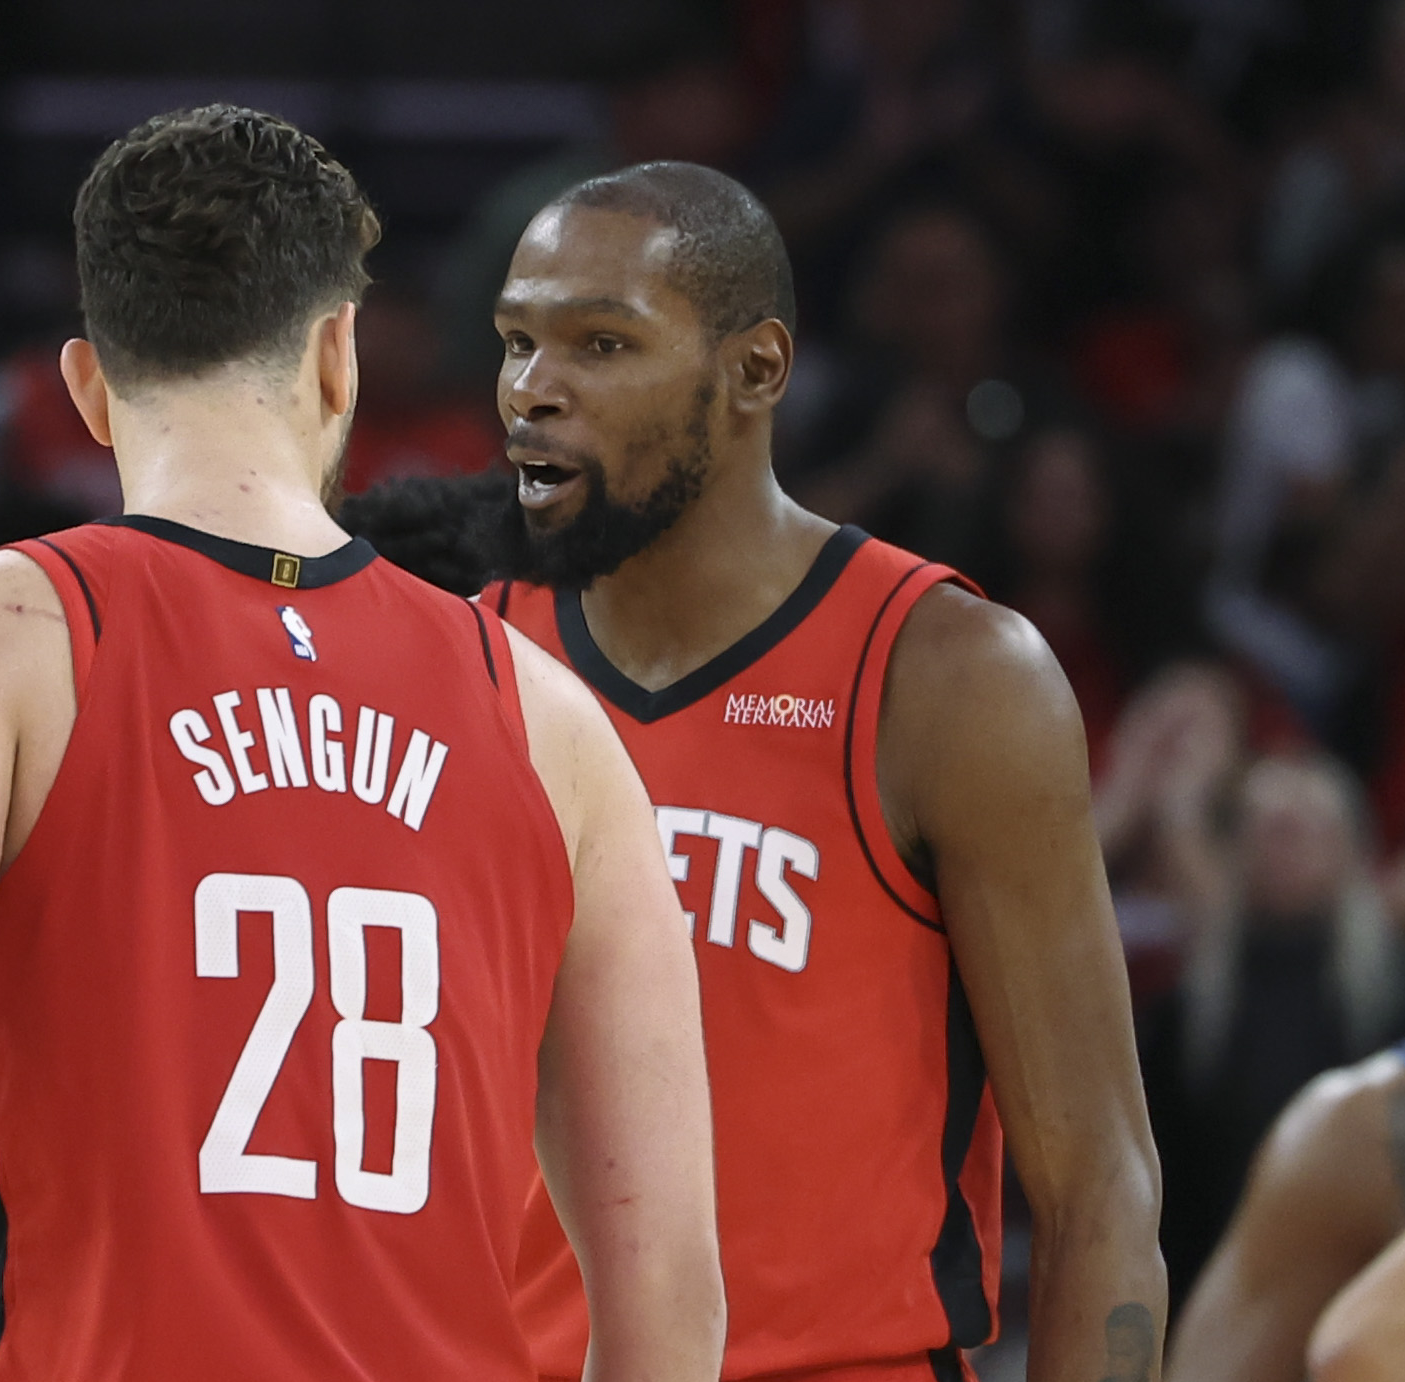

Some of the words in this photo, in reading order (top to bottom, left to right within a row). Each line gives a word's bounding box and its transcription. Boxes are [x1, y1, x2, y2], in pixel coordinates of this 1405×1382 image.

[723, 706, 834, 728] HERMANN
[725, 693, 835, 716] MEMORIAL
[169, 688, 448, 832] SENGUN
[194, 873, 440, 1214] 28
